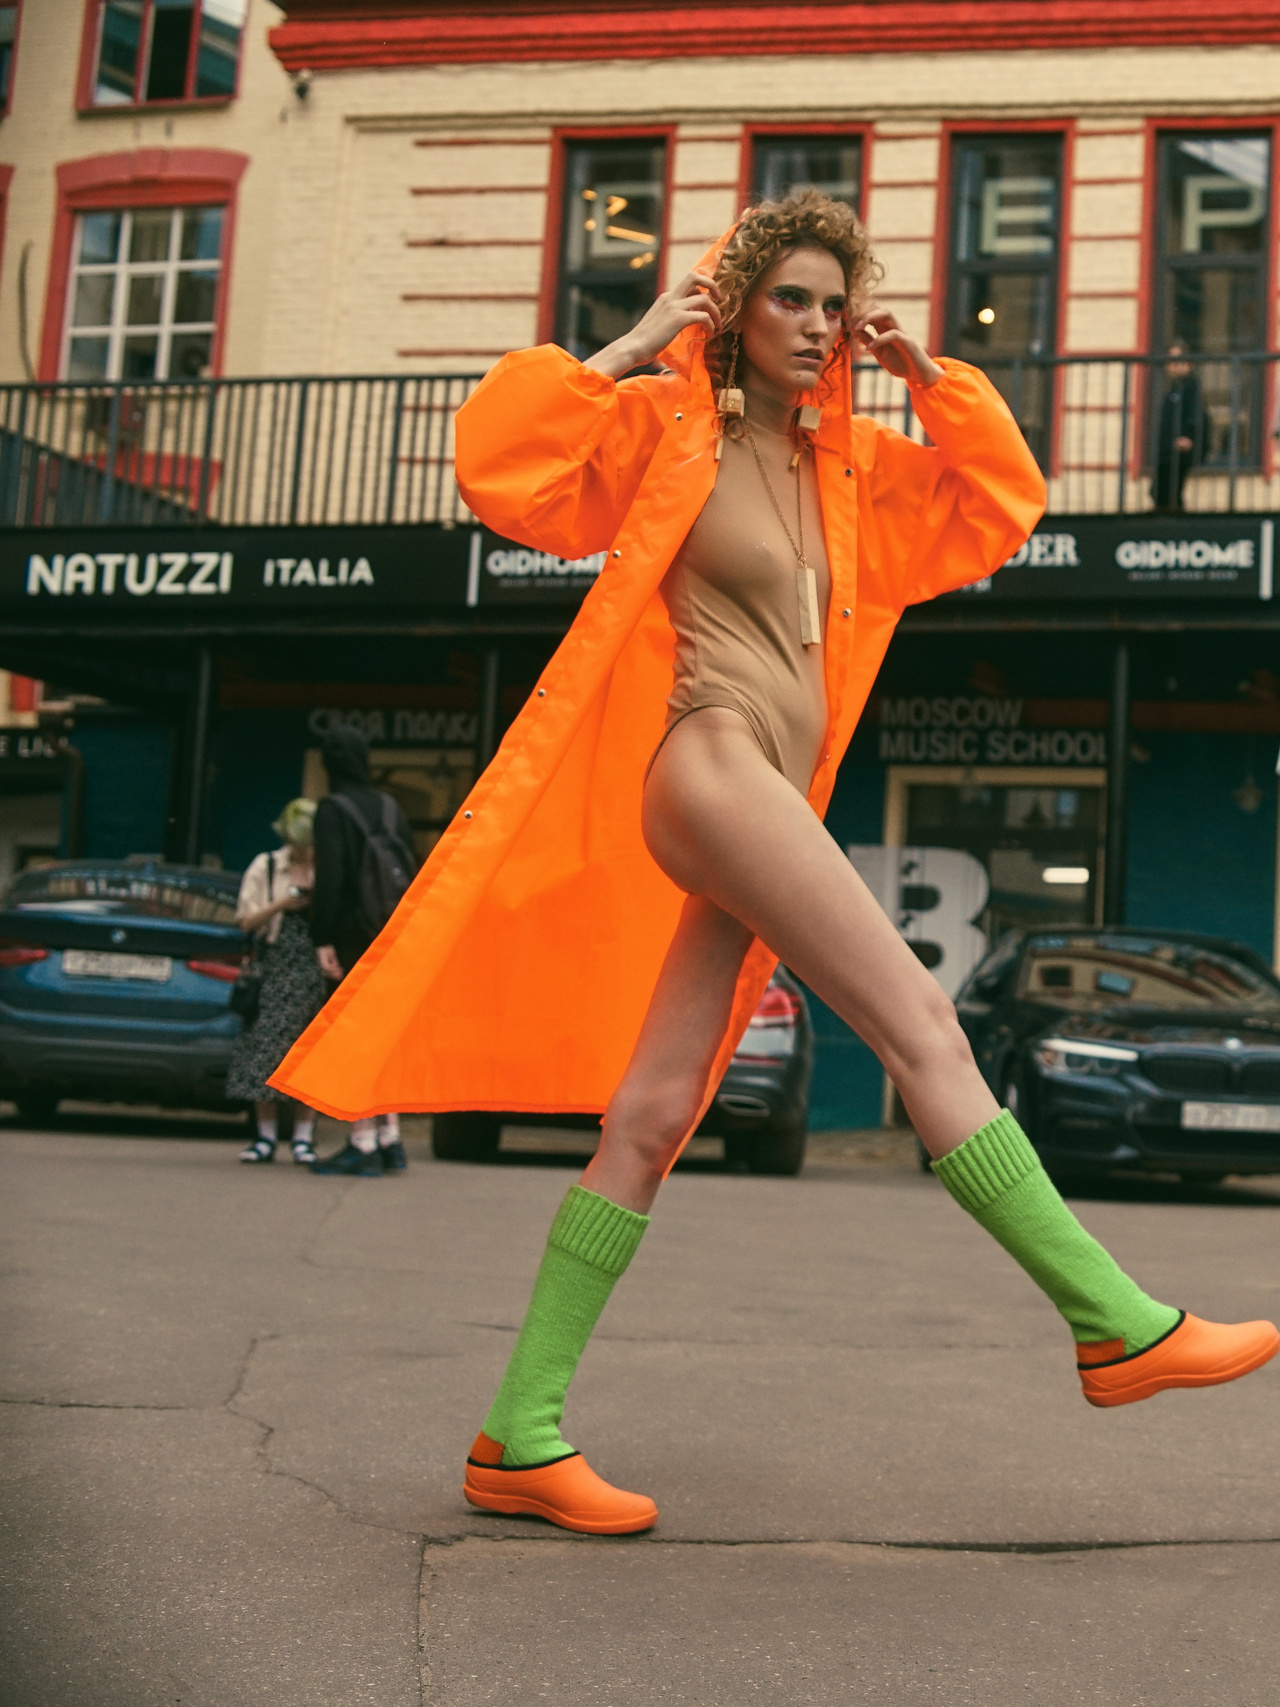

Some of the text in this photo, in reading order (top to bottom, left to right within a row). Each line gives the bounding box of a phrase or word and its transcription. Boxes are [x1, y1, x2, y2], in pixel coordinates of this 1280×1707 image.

[1115, 538, 1256, 569] GIDHOME
[25, 551, 375, 597] NATUZZI ITALIA
[878, 696, 1024, 729] MOSCOW
[878, 730, 979, 763] MUSIC
